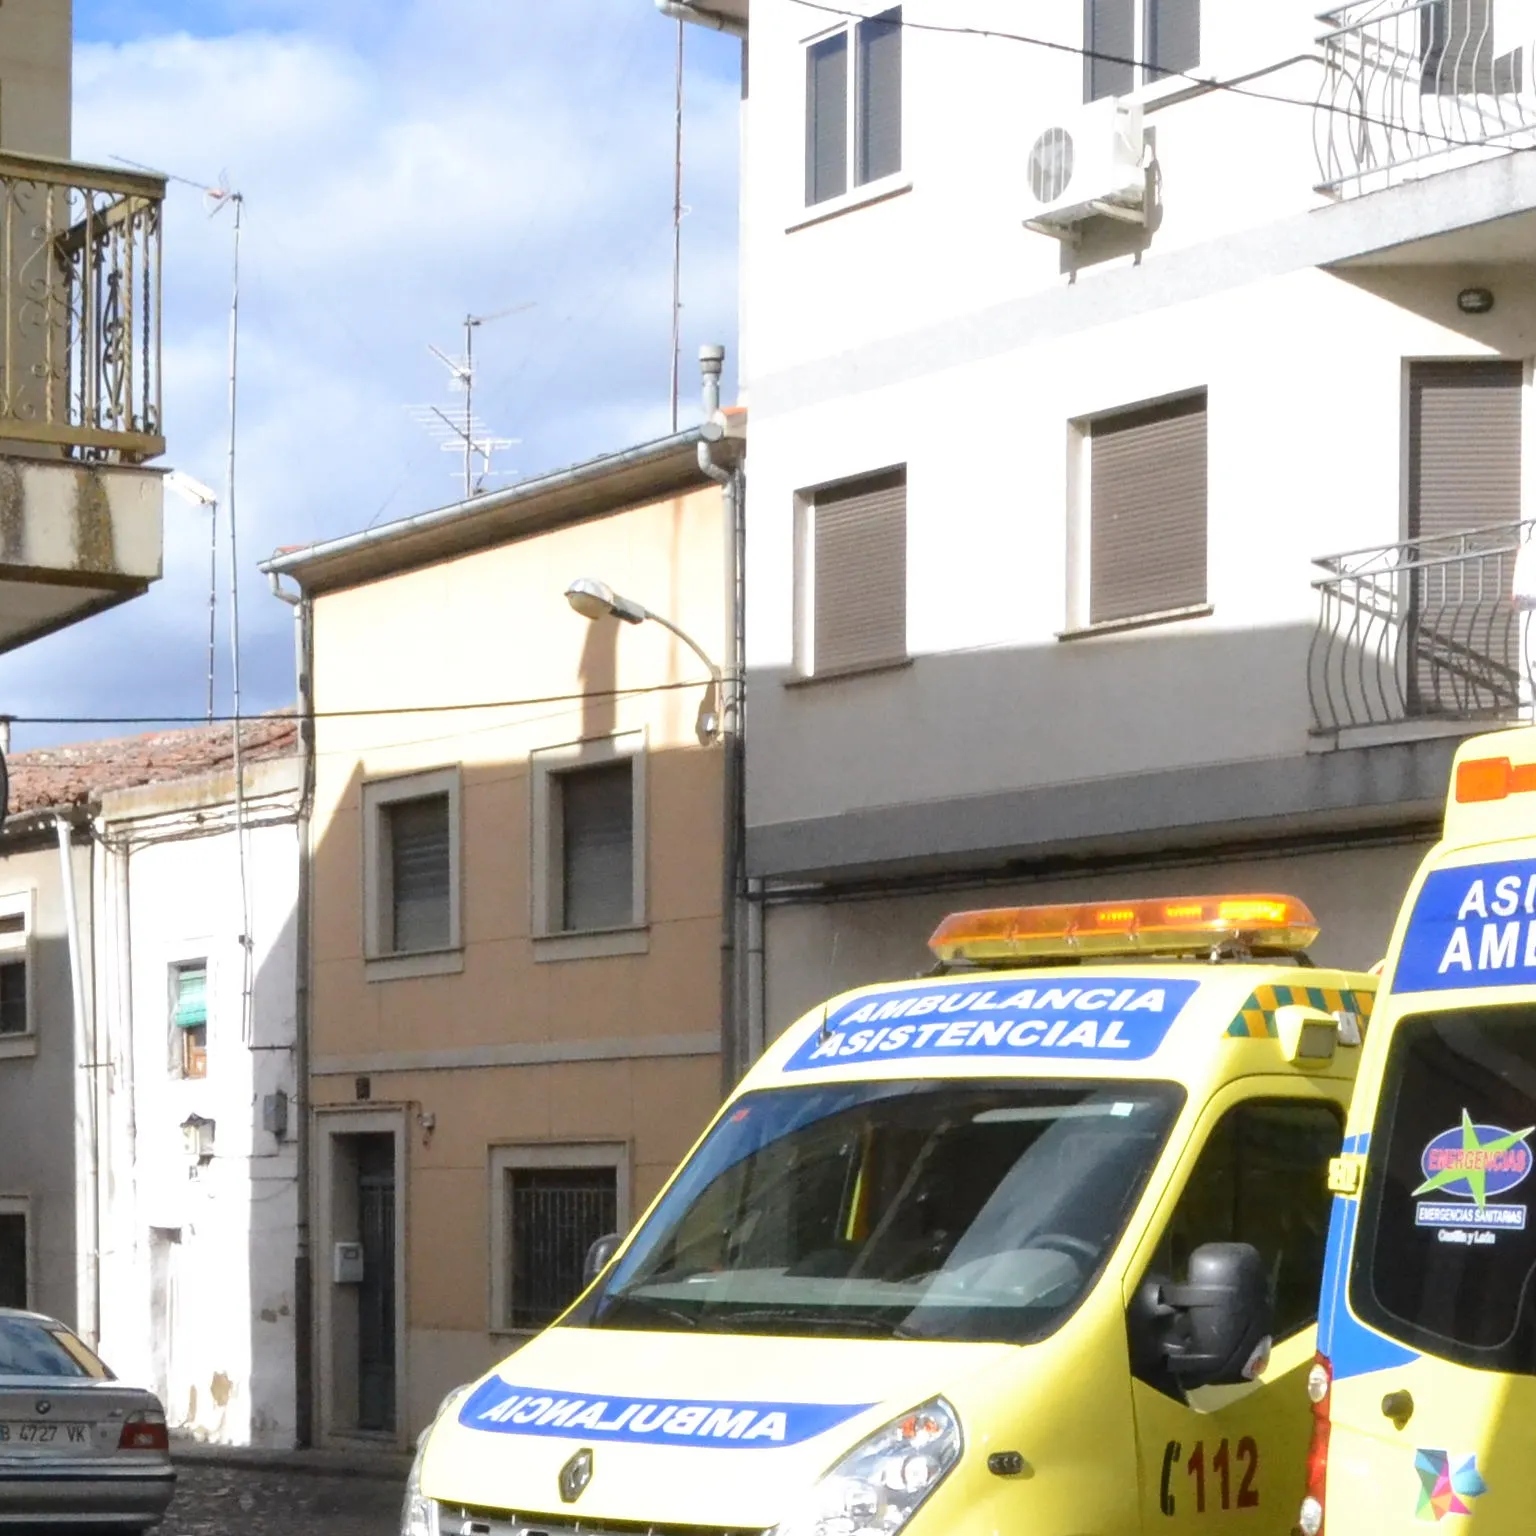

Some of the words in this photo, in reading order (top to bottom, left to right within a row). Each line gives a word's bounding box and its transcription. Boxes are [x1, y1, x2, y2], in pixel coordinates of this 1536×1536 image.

[839, 987, 1167, 1027] AMBULANCIA
[808, 1018, 1133, 1061] ASISTENCIAL
[1427, 1148, 1528, 1173] EMERGENCIAS
[1419, 1206, 1474, 1223] EMERGENCIAS
[19, 1424, 58, 1442] 4727
[67, 1424, 87, 1443] VK
[1187, 1434, 1261, 1513] 112
